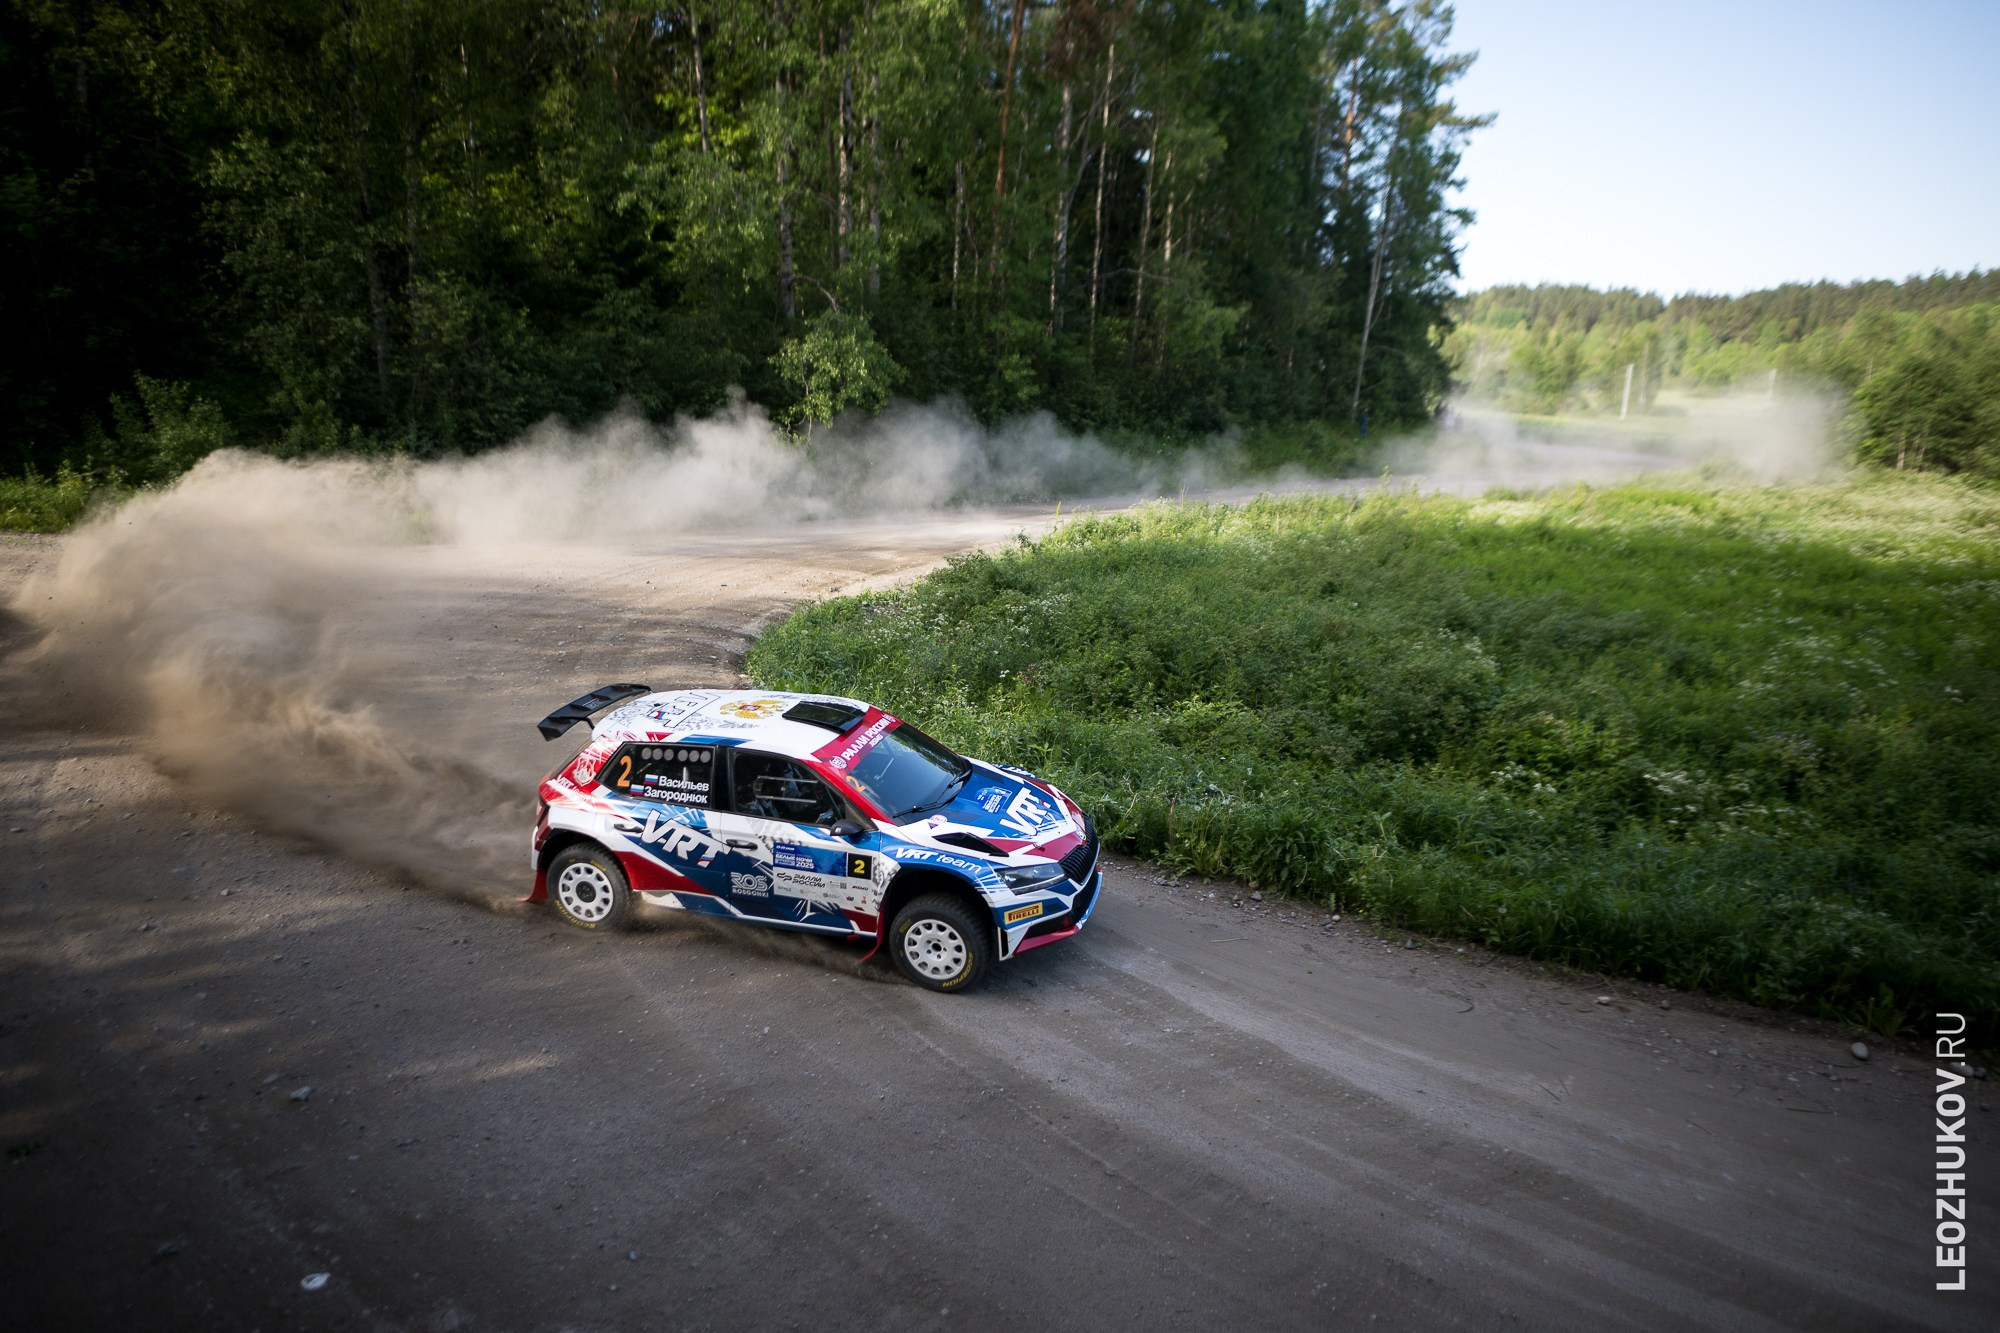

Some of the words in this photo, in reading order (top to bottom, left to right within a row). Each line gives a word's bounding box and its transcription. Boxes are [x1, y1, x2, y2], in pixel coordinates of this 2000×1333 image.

[841, 735, 868, 761] РАЛЛИ
[616, 755, 633, 787] 2
[658, 775, 710, 792] Васильев
[845, 775, 867, 792] 2
[644, 786, 709, 804] Загороднюк
[999, 787, 1052, 836] VRT
[640, 810, 736, 868] VRT
[853, 859, 866, 874] 2
[895, 847, 939, 861] VRT
[936, 853, 984, 875] team
[730, 871, 769, 892] ROS
[732, 888, 769, 898] ROSGONKI
[1007, 904, 1040, 921] PIRELLI
[942, 951, 974, 988] SCORPION
